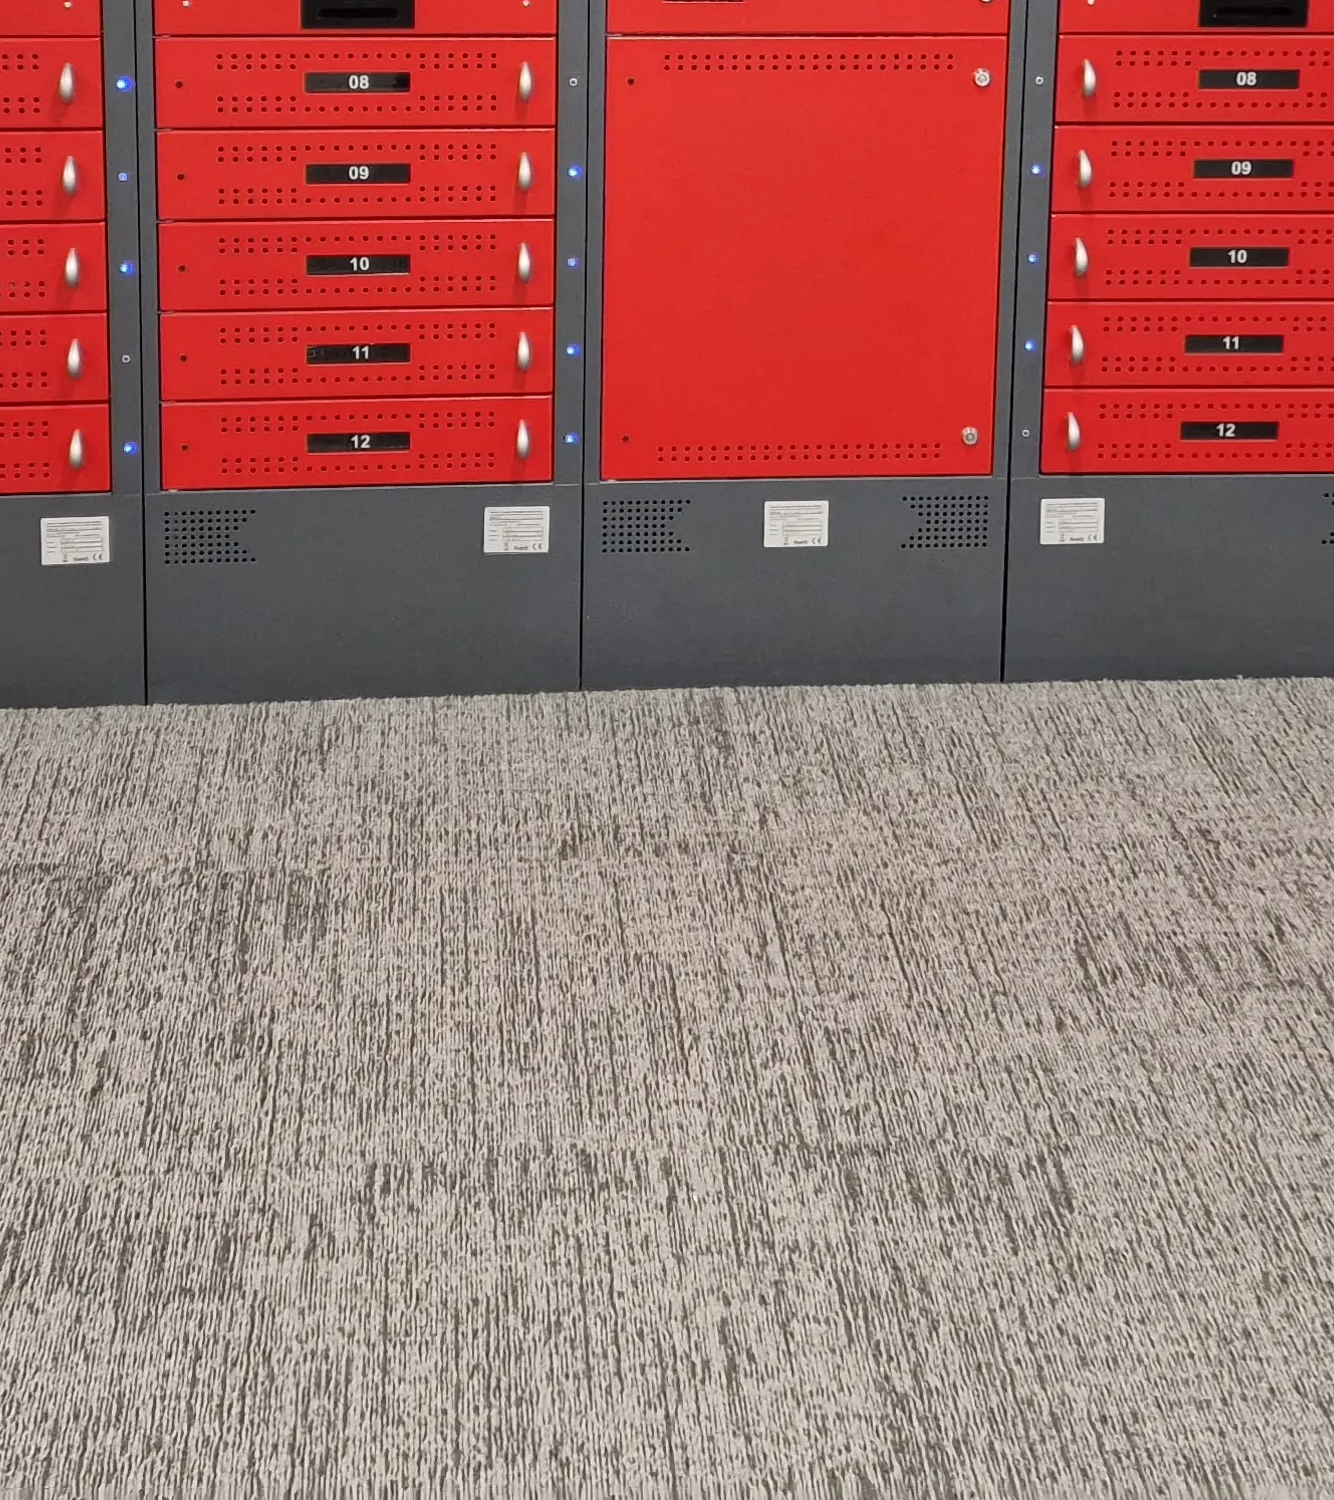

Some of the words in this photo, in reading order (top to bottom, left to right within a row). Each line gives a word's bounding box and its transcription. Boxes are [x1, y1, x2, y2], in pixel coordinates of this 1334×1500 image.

[348, 74, 370, 90] 08
[1236, 71, 1257, 86] 08
[348, 165, 370, 180] 09
[1231, 161, 1252, 175] 09
[349, 256, 370, 272] 10
[1228, 249, 1248, 264] 10
[1222, 336, 1239, 350] 11
[352, 345, 369, 360] 11
[1216, 423, 1236, 438] 12
[351, 434, 371, 449] 12
